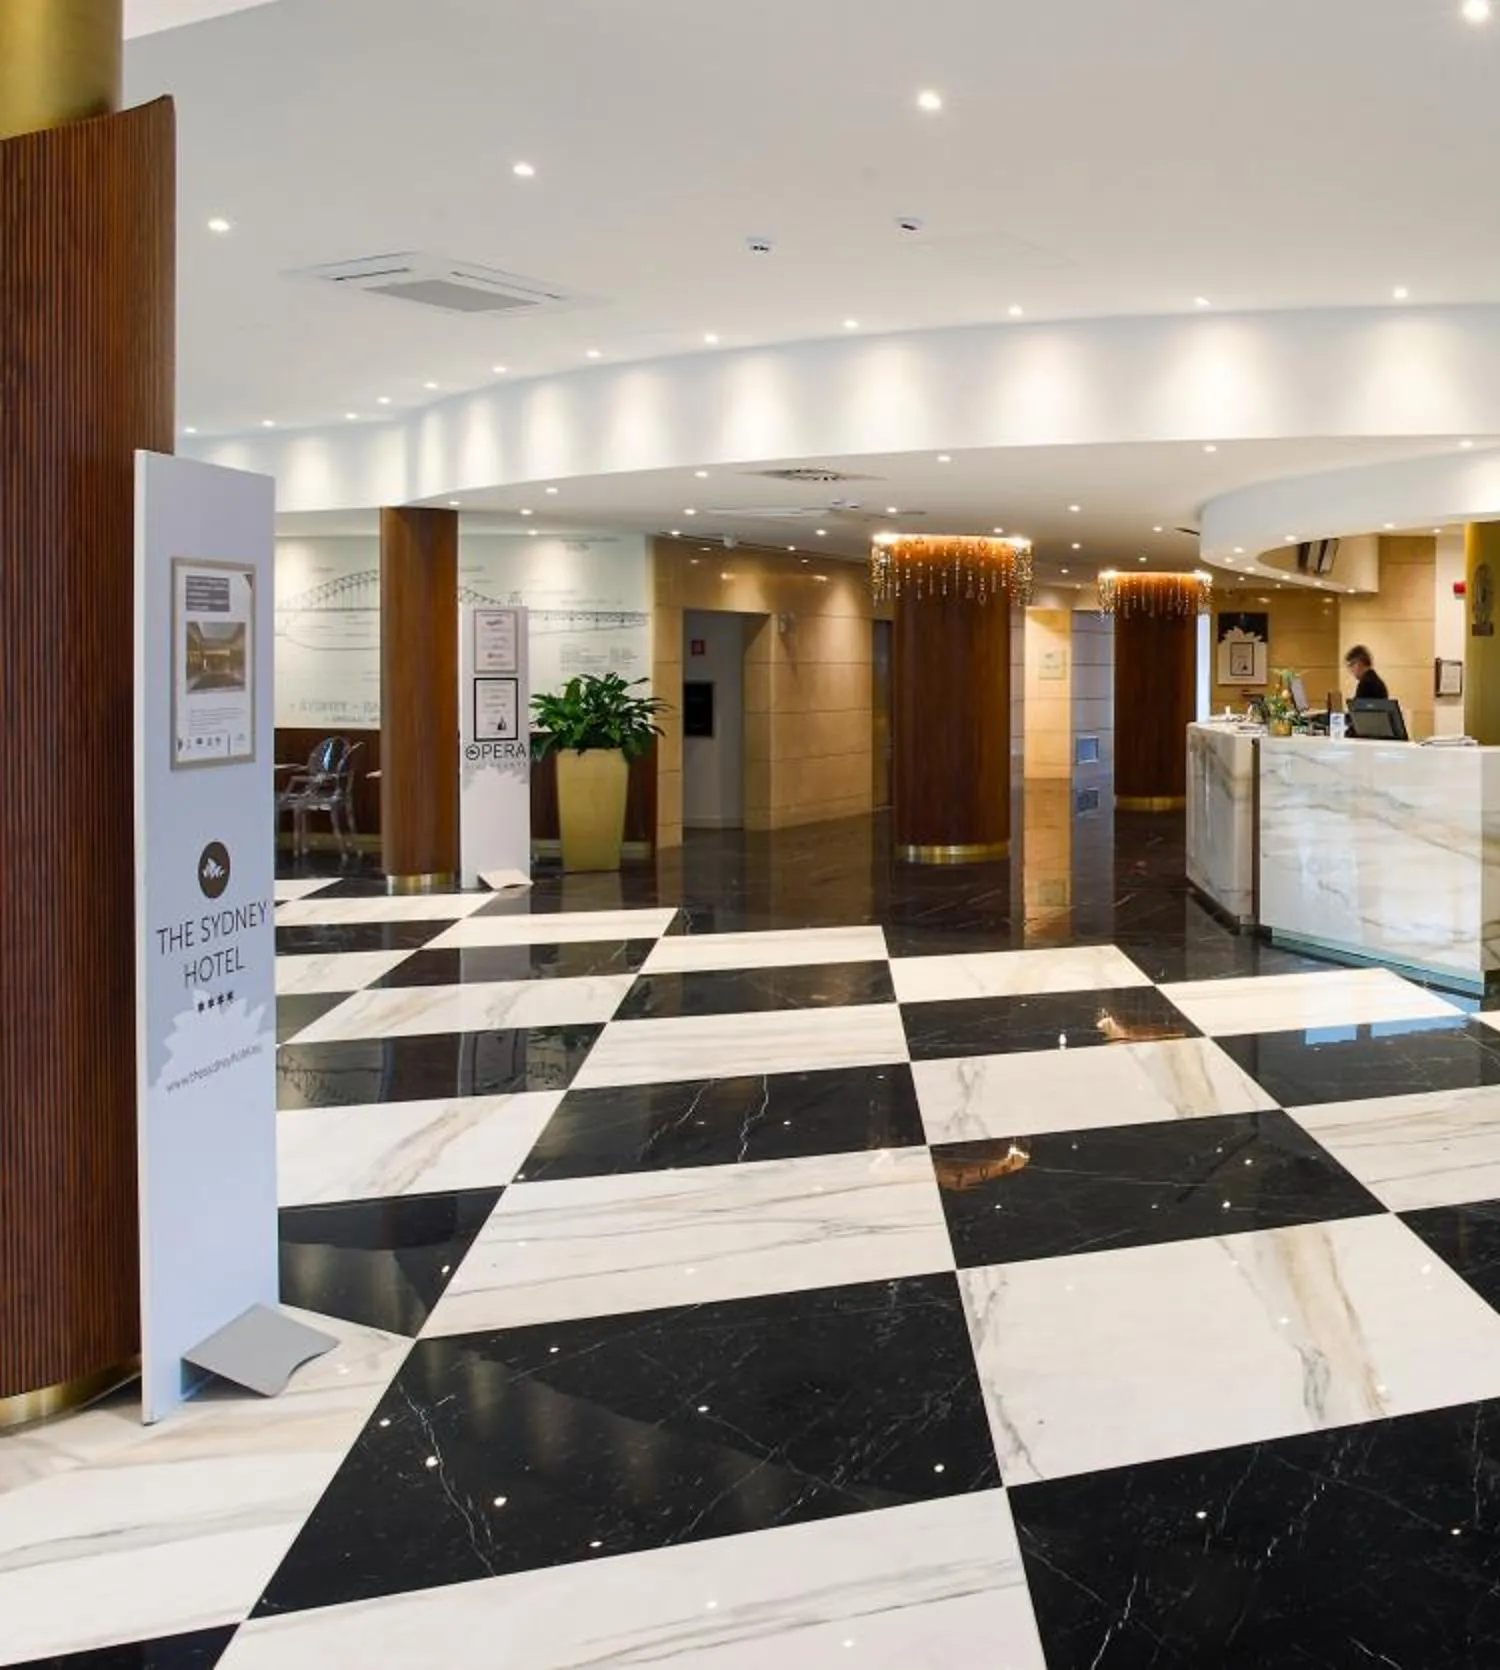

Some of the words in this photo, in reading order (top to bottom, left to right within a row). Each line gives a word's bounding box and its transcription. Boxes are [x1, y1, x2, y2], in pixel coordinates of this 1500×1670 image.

[465, 743, 527, 760] OPERA
[156, 921, 195, 955] THE
[201, 901, 267, 943] SYDNEY
[184, 946, 245, 988] HOTEL
